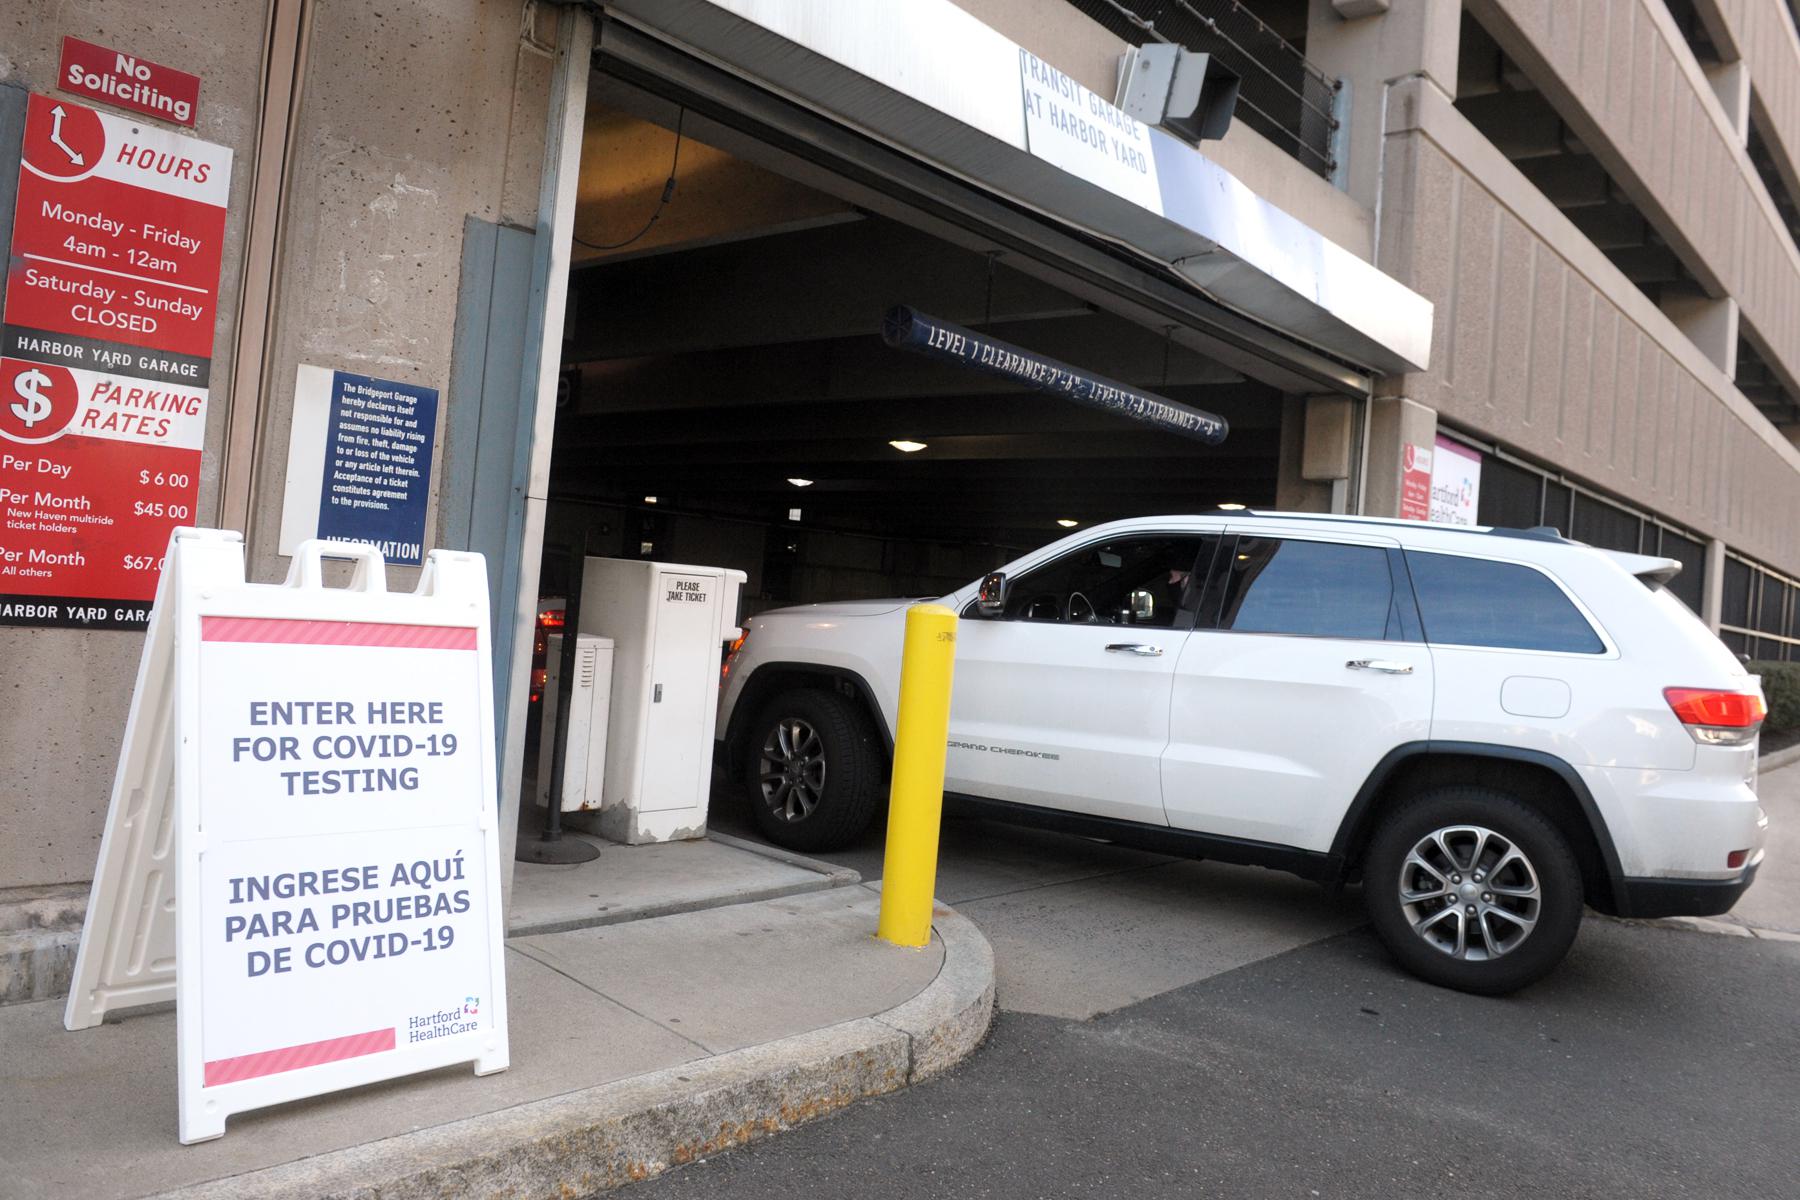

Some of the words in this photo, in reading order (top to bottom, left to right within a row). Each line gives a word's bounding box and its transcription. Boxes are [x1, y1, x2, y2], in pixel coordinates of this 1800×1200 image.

[115, 53, 151, 80] No
[68, 64, 191, 121] Soliciting
[1020, 50, 1082, 107] TRANSIT
[1089, 91, 1141, 141] GARAGE
[1026, 89, 1042, 119] AT
[1049, 102, 1108, 155] HARBOR
[1112, 138, 1147, 174] YARD
[116, 143, 212, 183] HOURS
[41, 200, 124, 237] Monday
[143, 223, 201, 252] Friday
[63, 235, 106, 258] 4am
[127, 249, 177, 273] 12am
[25, 268, 115, 302] Saturday
[133, 290, 202, 320] Sunday
[71, 305, 157, 333] CLOSED
[18, 336, 84, 359] HARBOR
[92, 349, 132, 367] YARD
[139, 356, 199, 377] GARAGE
[928, 326, 966, 356] LEVEL
[971, 341, 979, 359] 1
[981, 345, 1047, 382] CLEARANCE
[1147, 401, 1194, 429] CLEARANCE
[90, 382, 202, 417] PARKING
[343, 382, 356, 393] The
[357, 385, 393, 399] Bridgeport
[394, 392, 418, 405] Garage
[341, 395, 366, 409] hereby
[367, 400, 396, 413] declares
[396, 405, 414, 416] itself
[81, 408, 171, 437] RATES
[340, 409, 352, 418] not
[353, 412, 393, 424] responsible
[393, 416, 404, 426] for
[404, 420, 418, 428] and
[338, 433, 355, 443] from
[391, 441, 418, 454] damage
[339, 422, 369, 433] assumes
[370, 427, 380, 435] no
[380, 427, 405, 440] liability
[406, 431, 425, 444] rising
[335, 459, 344, 467] or
[344, 461, 357, 471] any
[358, 462, 381, 472] article
[382, 464, 394, 474] left
[336, 446, 344, 455] to
[354, 448, 369, 458] loss
[370, 451, 378, 459] of
[379, 452, 390, 461] the
[391, 454, 415, 464] vehicle
[2, 455, 32, 471] Per
[38, 459, 72, 479] Day
[333, 470, 374, 484] Acceptance
[374, 476, 382, 484] of
[389, 477, 408, 488] ticket
[0, 488, 29, 505] Per
[34, 492, 91, 510] Month
[331, 495, 339, 504] to
[340, 496, 352, 506] the
[332, 484, 371, 496] constitutes
[371, 489, 408, 500] agreement
[1433, 484, 1459, 507] artford
[7, 508, 32, 518] New
[34, 510, 67, 521] Haven
[69, 514, 114, 525] multiride
[7, 520, 36, 531] ticket
[39, 523, 78, 534] holders
[28, 549, 86, 566] Month
[2, 566, 17, 575] All
[19, 568, 53, 578] others
[666, 591, 683, 601] TAKE
[685, 592, 706, 602] TICKET
[676, 581, 700, 591] PLEASE
[0, 603, 58, 619] ARBOR
[66, 606, 107, 621] YARD
[249, 701, 356, 726] ENTER
[367, 701, 444, 724] HERE
[232, 736, 301, 762] FOR
[312, 733, 458, 759] COVID-19
[947, 740, 987, 752] GRAND
[990, 746, 1060, 760] CHEROKEE
[280, 768, 419, 796] TESTING
[228, 865, 379, 904] INGRESE
[390, 850, 465, 891] AQUÍ
[225, 907, 320, 942] PARA
[331, 890, 471, 929] PRUEBAS
[247, 947, 292, 978] DE
[304, 926, 455, 970] COVID-19
[409, 1007, 461, 1029] Hartford
[409, 1021, 478, 1043] HealthCare
